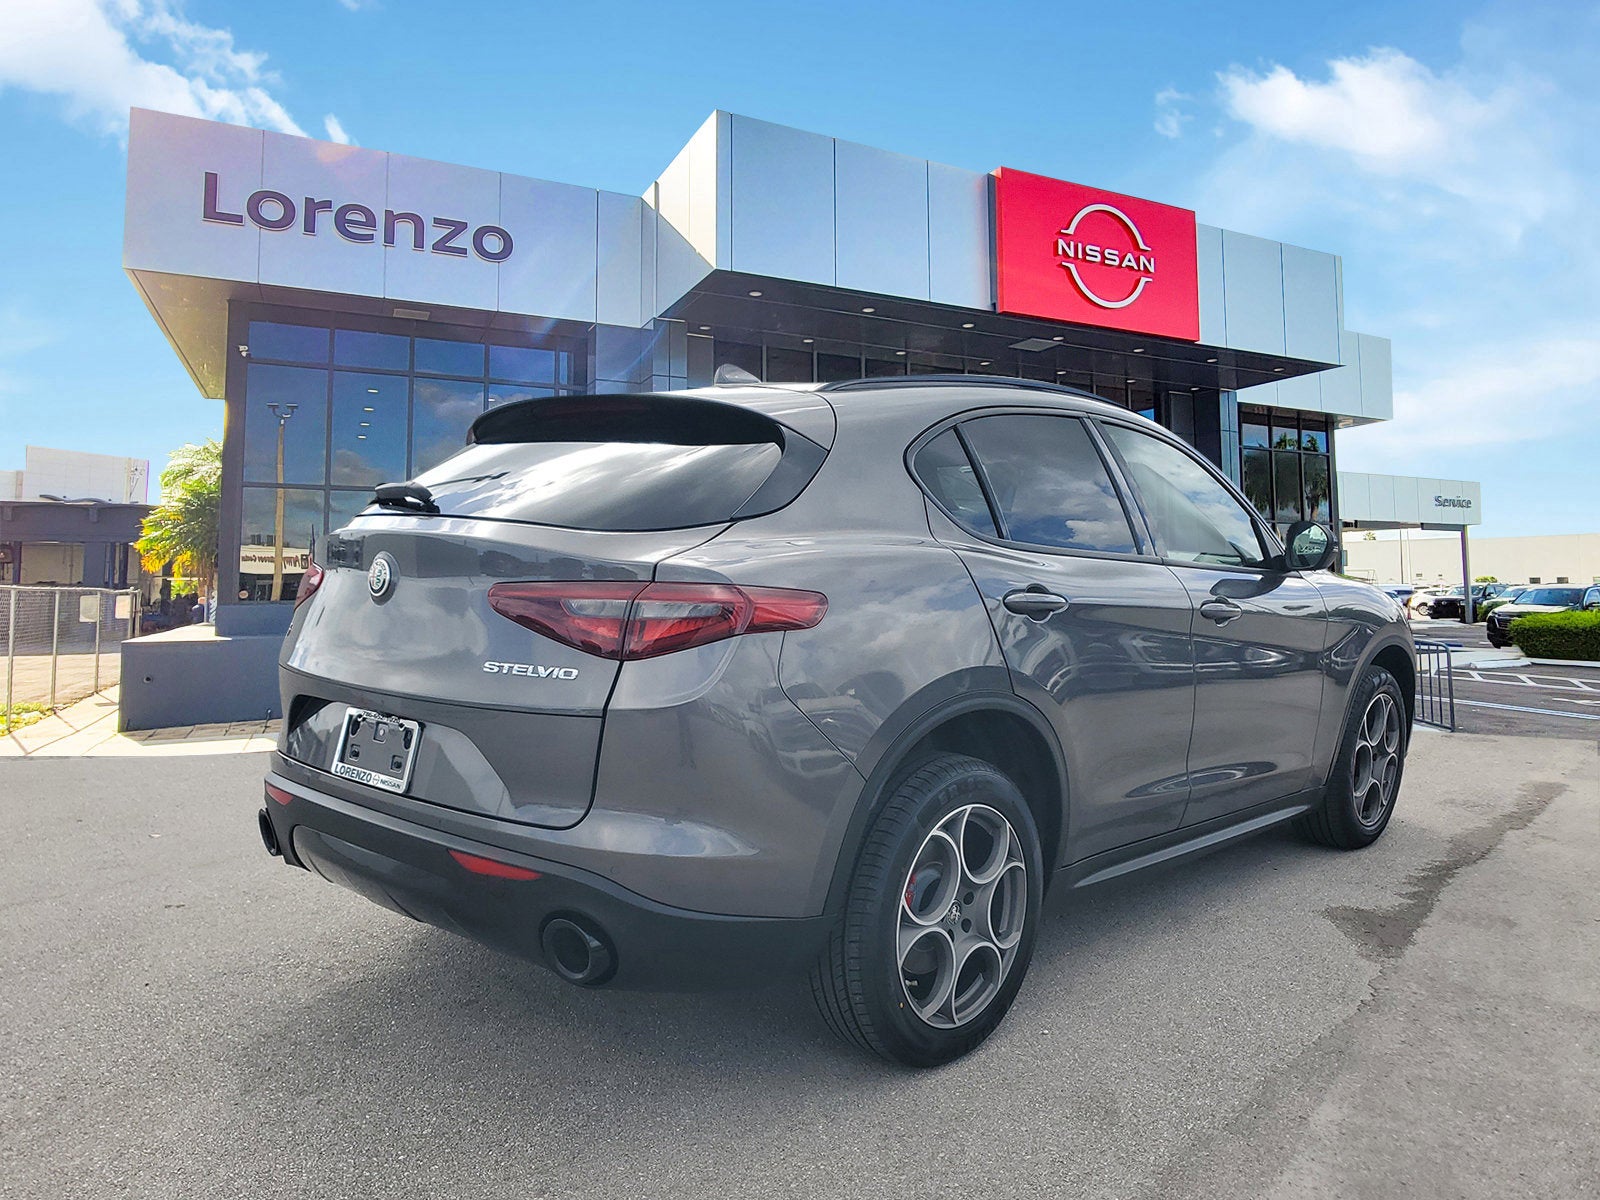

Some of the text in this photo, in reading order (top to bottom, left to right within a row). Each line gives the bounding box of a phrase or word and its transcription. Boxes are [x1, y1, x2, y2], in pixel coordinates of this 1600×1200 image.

[202, 171, 514, 262] Lorenzo
[1057, 238, 1155, 273] NISSAN
[1434, 495, 1472, 509] Service
[482, 660, 579, 680] STELVIO
[334, 763, 402, 790] LORENZO NISSAN
